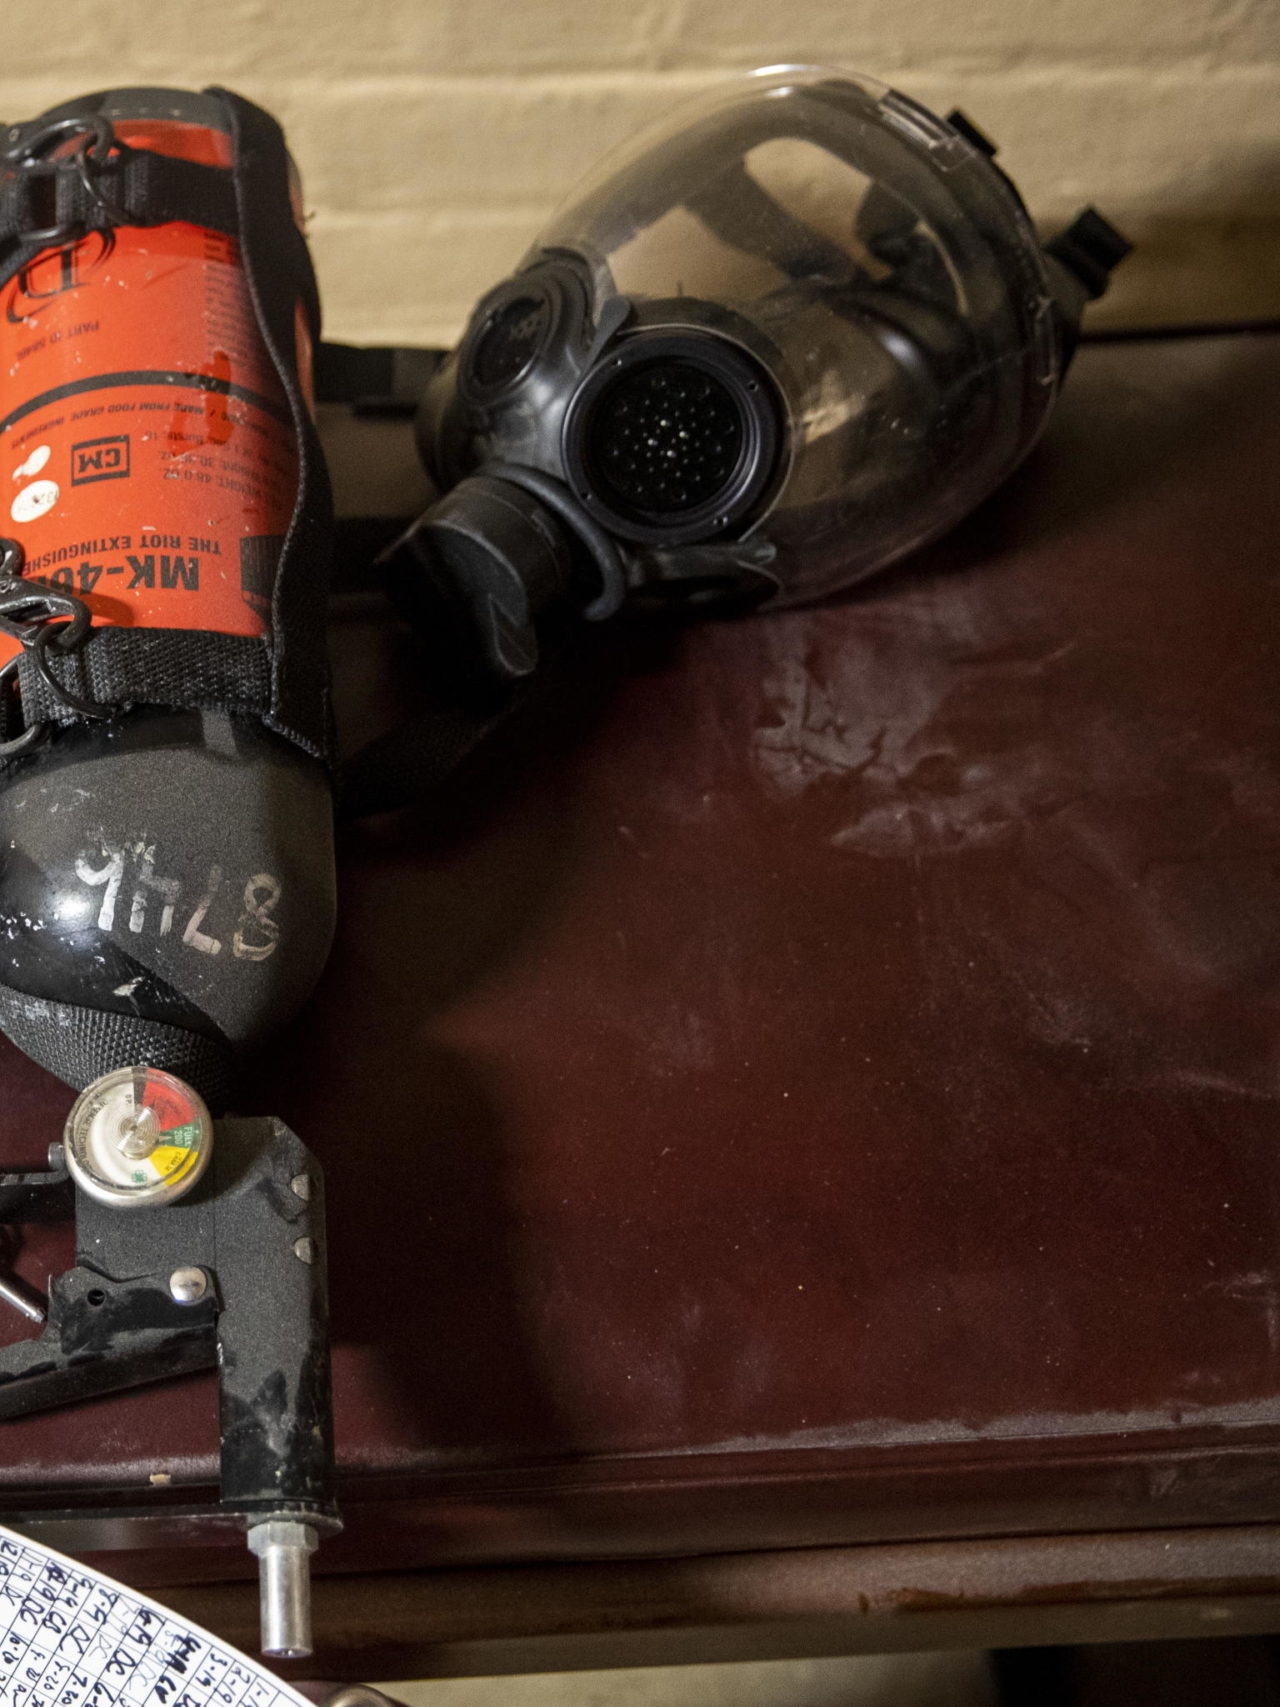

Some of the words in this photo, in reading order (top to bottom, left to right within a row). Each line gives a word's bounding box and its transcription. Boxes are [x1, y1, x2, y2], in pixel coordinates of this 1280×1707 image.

[70, 405, 105, 421] GRADE
[107, 403, 136, 413] FOOD
[139, 402, 170, 412] FROM
[11, 416, 65, 449] INGREDIENTS
[78, 447, 121, 473] CM
[140, 534, 182, 549] RIOT
[188, 536, 222, 554] THE
[22, 535, 132, 577] EXTINGUISHE
[75, 842, 281, 961] 8746
[173, 1130, 183, 1146] 200
[19, 1596, 46, 1626] DC
[106, 1648, 137, 1675] DC
